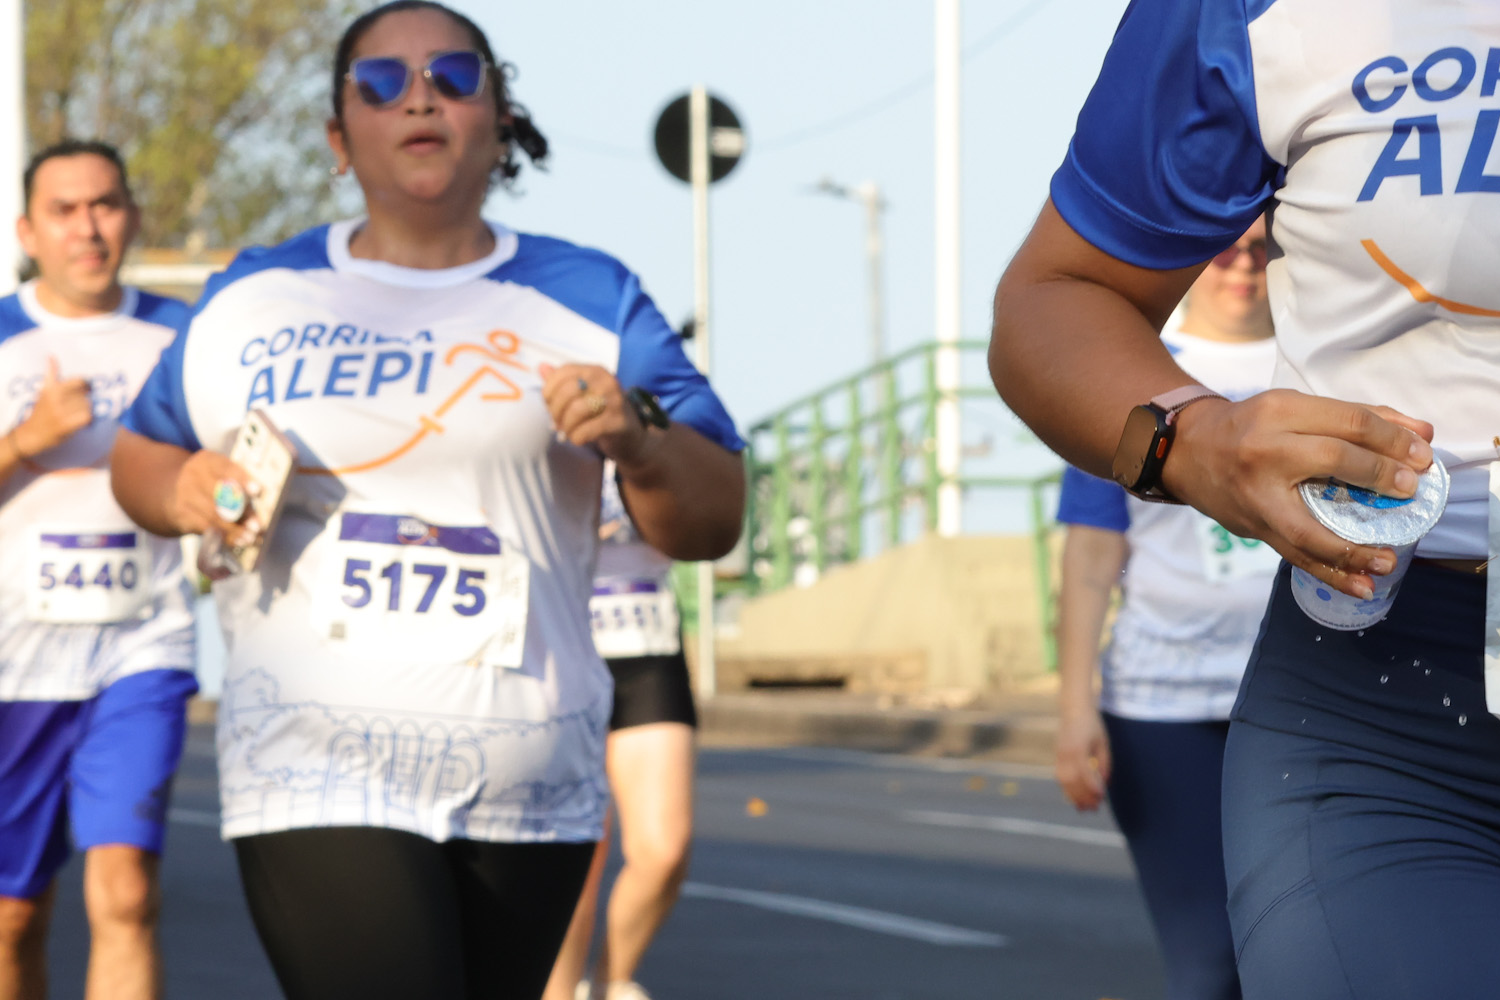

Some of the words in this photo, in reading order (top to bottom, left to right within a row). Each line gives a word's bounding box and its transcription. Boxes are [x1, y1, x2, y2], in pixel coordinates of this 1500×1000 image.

[246, 351, 433, 411] ALEPI
[40, 561, 138, 590] 5440
[341, 558, 486, 617] 5175
